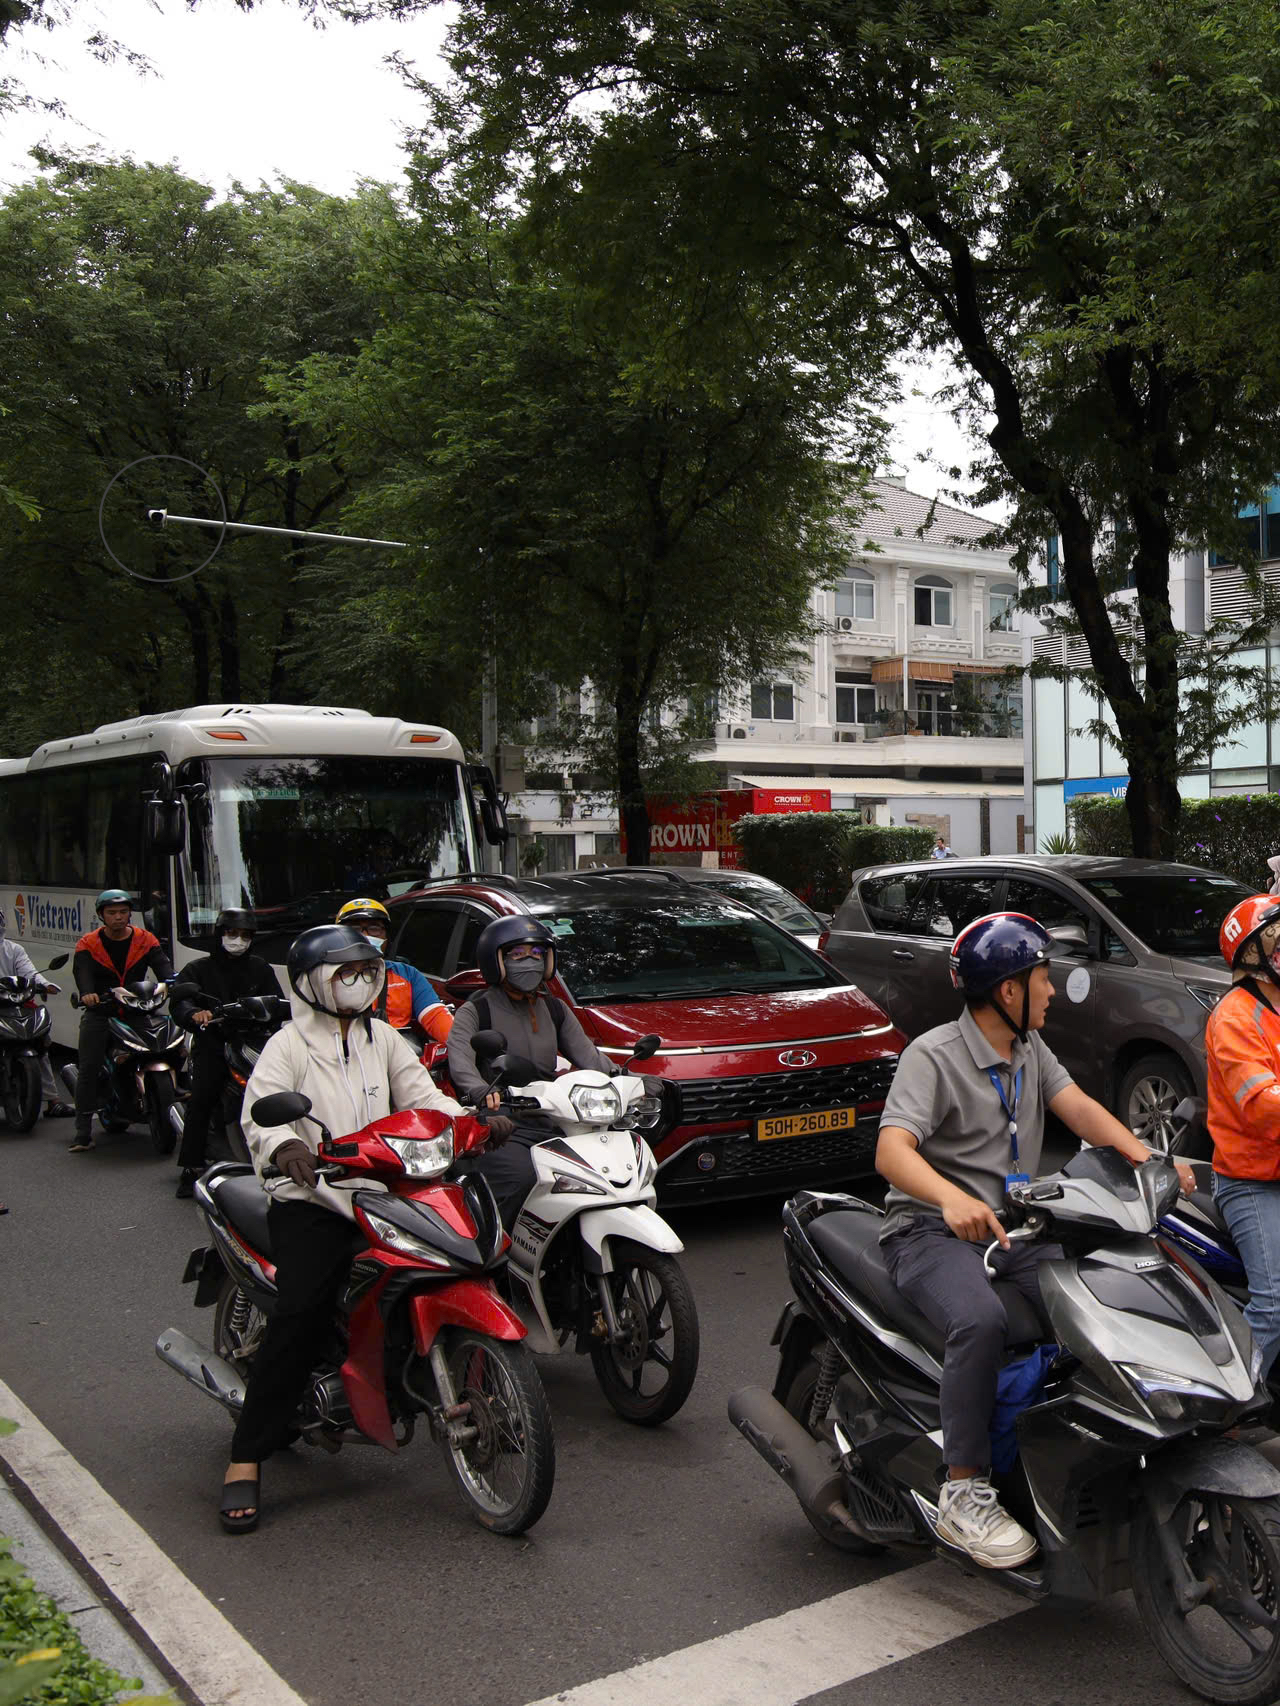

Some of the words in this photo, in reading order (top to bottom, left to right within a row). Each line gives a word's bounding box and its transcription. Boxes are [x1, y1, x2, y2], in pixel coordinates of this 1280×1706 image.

[1112, 787, 1127, 798] VIB
[650, 823, 710, 848] ROWN
[27, 895, 82, 933] Vietravel
[512, 1234, 537, 1257] YAMAHA
